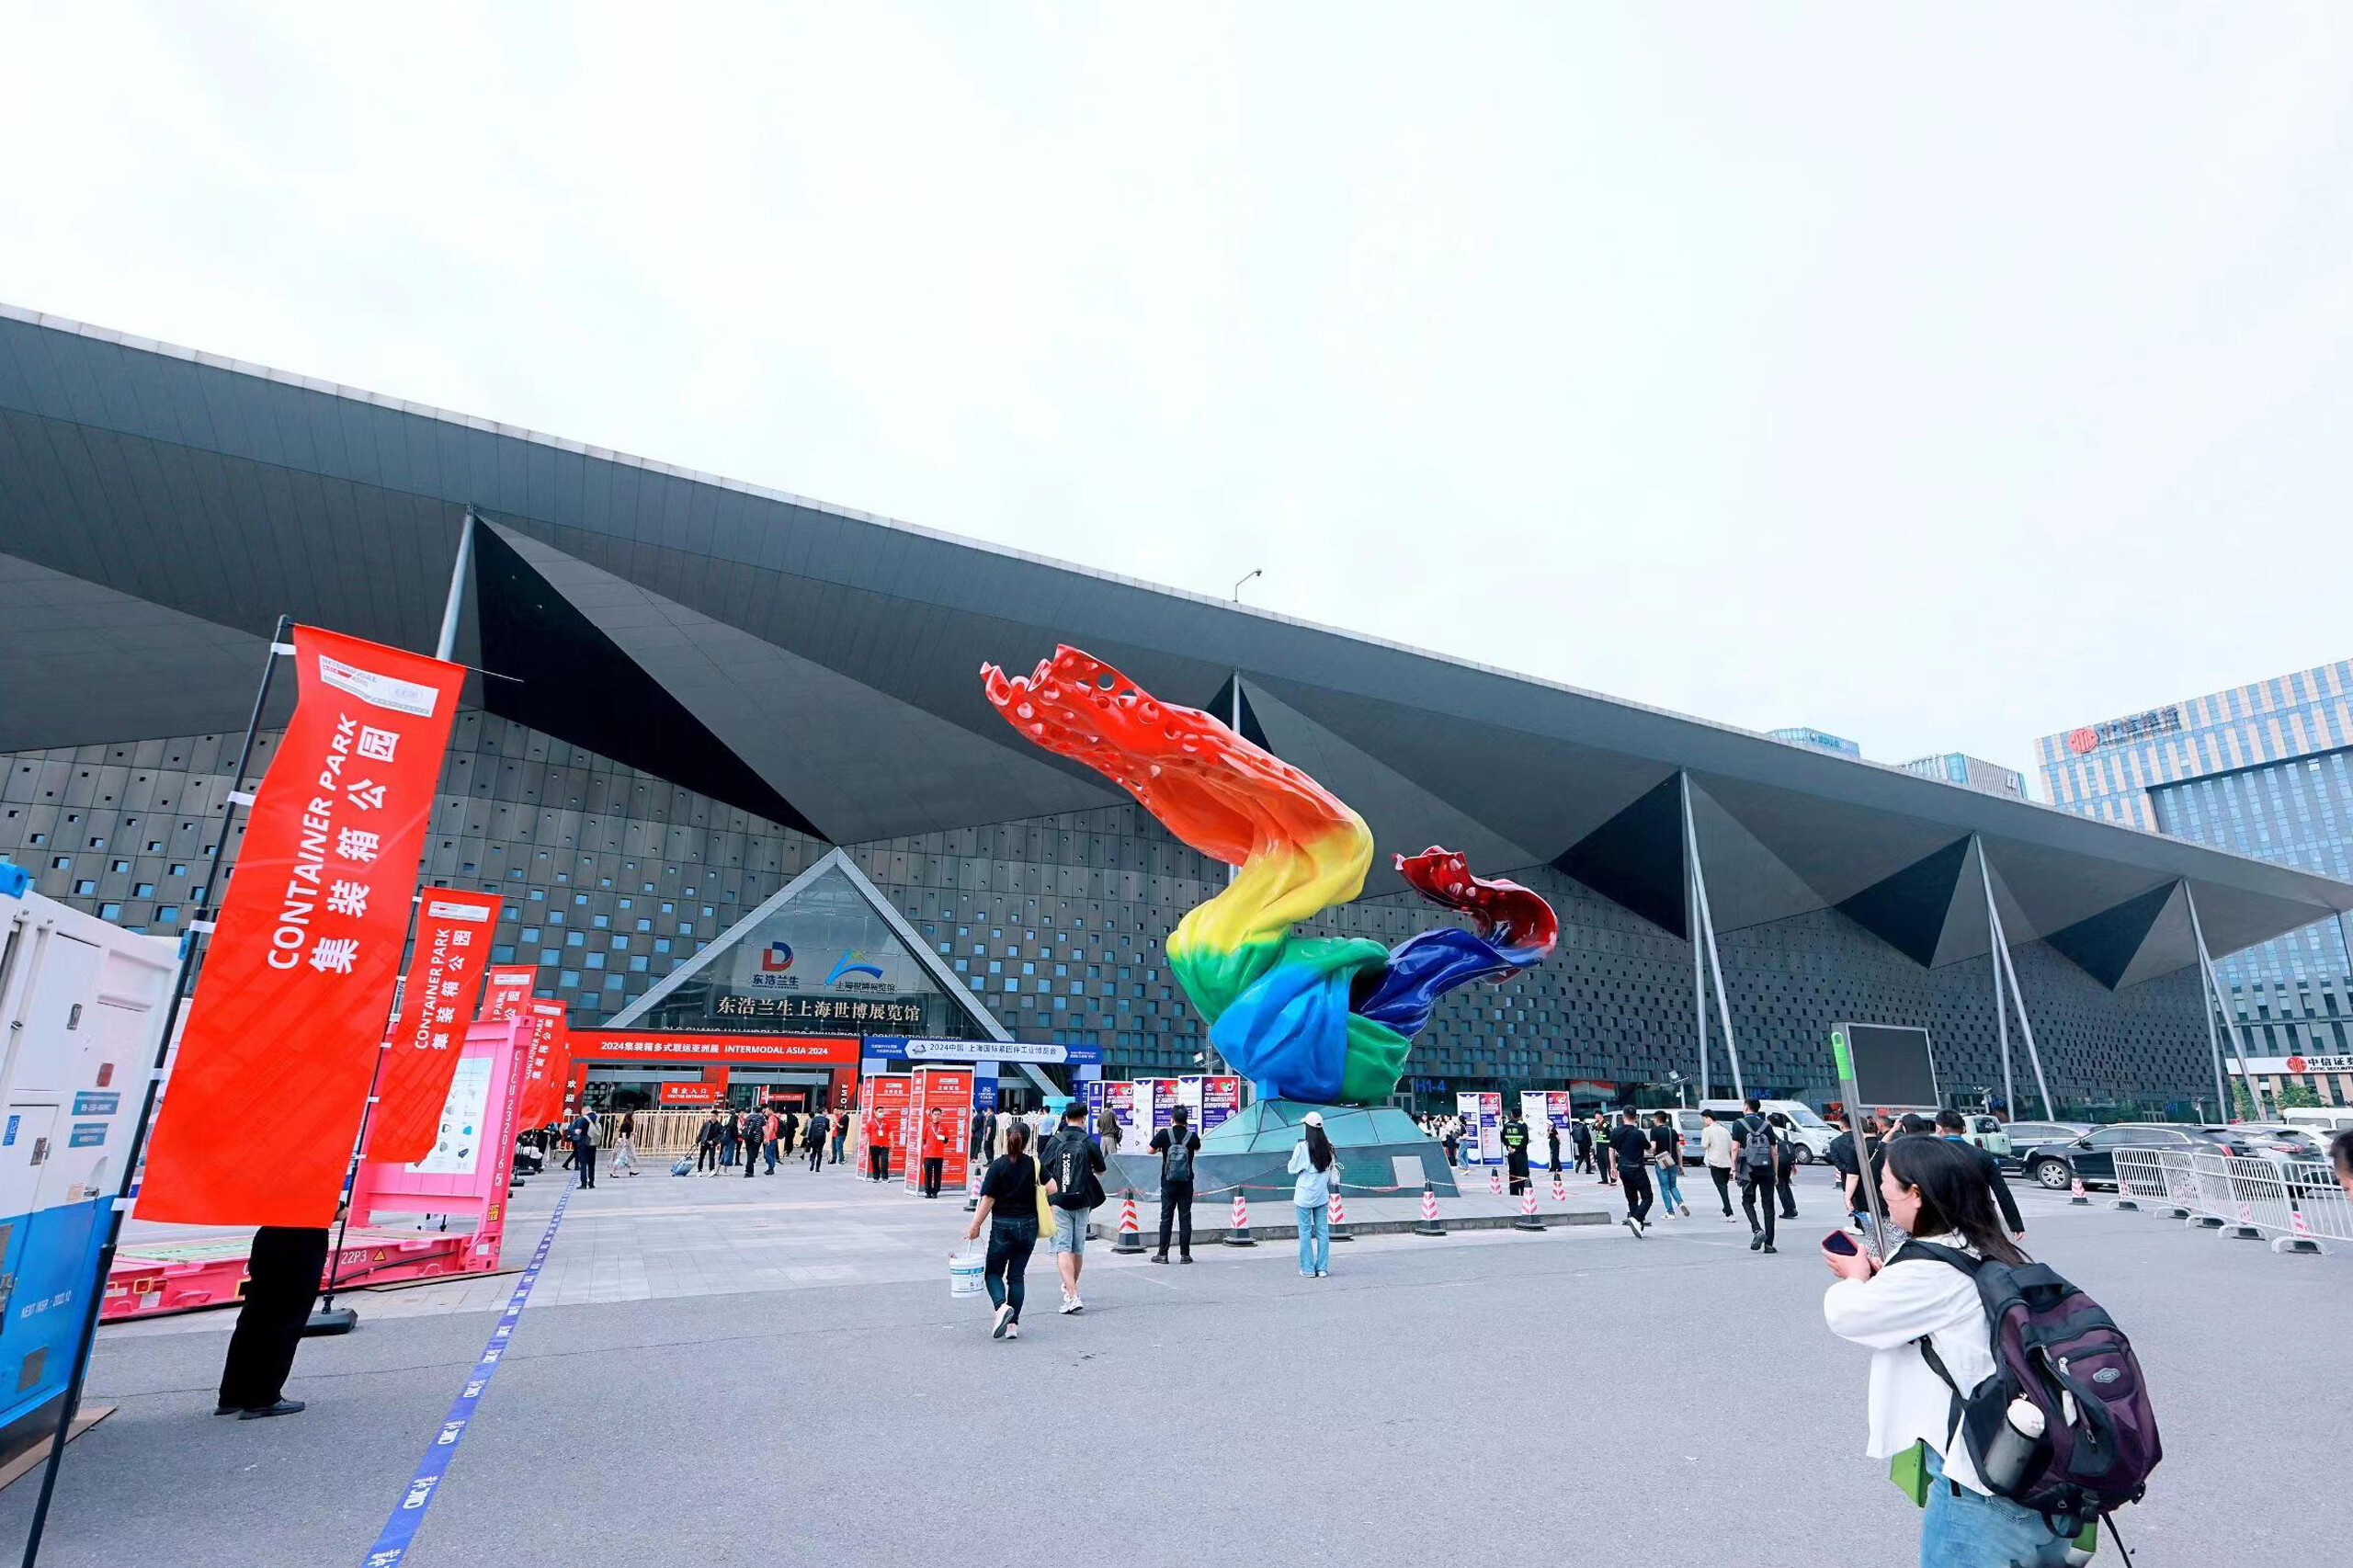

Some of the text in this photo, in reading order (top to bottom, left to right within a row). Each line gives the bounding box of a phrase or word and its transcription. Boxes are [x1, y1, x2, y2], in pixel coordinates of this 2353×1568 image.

[267, 712, 358, 970] CONTAINER PARK
[308, 725, 400, 975] 集装箱公园
[415, 928, 450, 1050] CONTAINER PARK
[431, 929, 472, 1050] 集装箱公园
[752, 974, 800, 986] 东浩兰生
[493, 991, 506, 1016] PARK
[716, 996, 921, 1022] 东浩兰生上海世博展览馆
[534, 1017, 545, 1037] PARK
[724, 1044, 784, 1054] INTERMODAL
[786, 1046, 806, 1054] ASIA
[808, 1047, 828, 1055] 2024
[509, 1050, 521, 1096] CICU
[498, 1100, 514, 1169] 232016
[340, 1250, 367, 1265] 22P3
